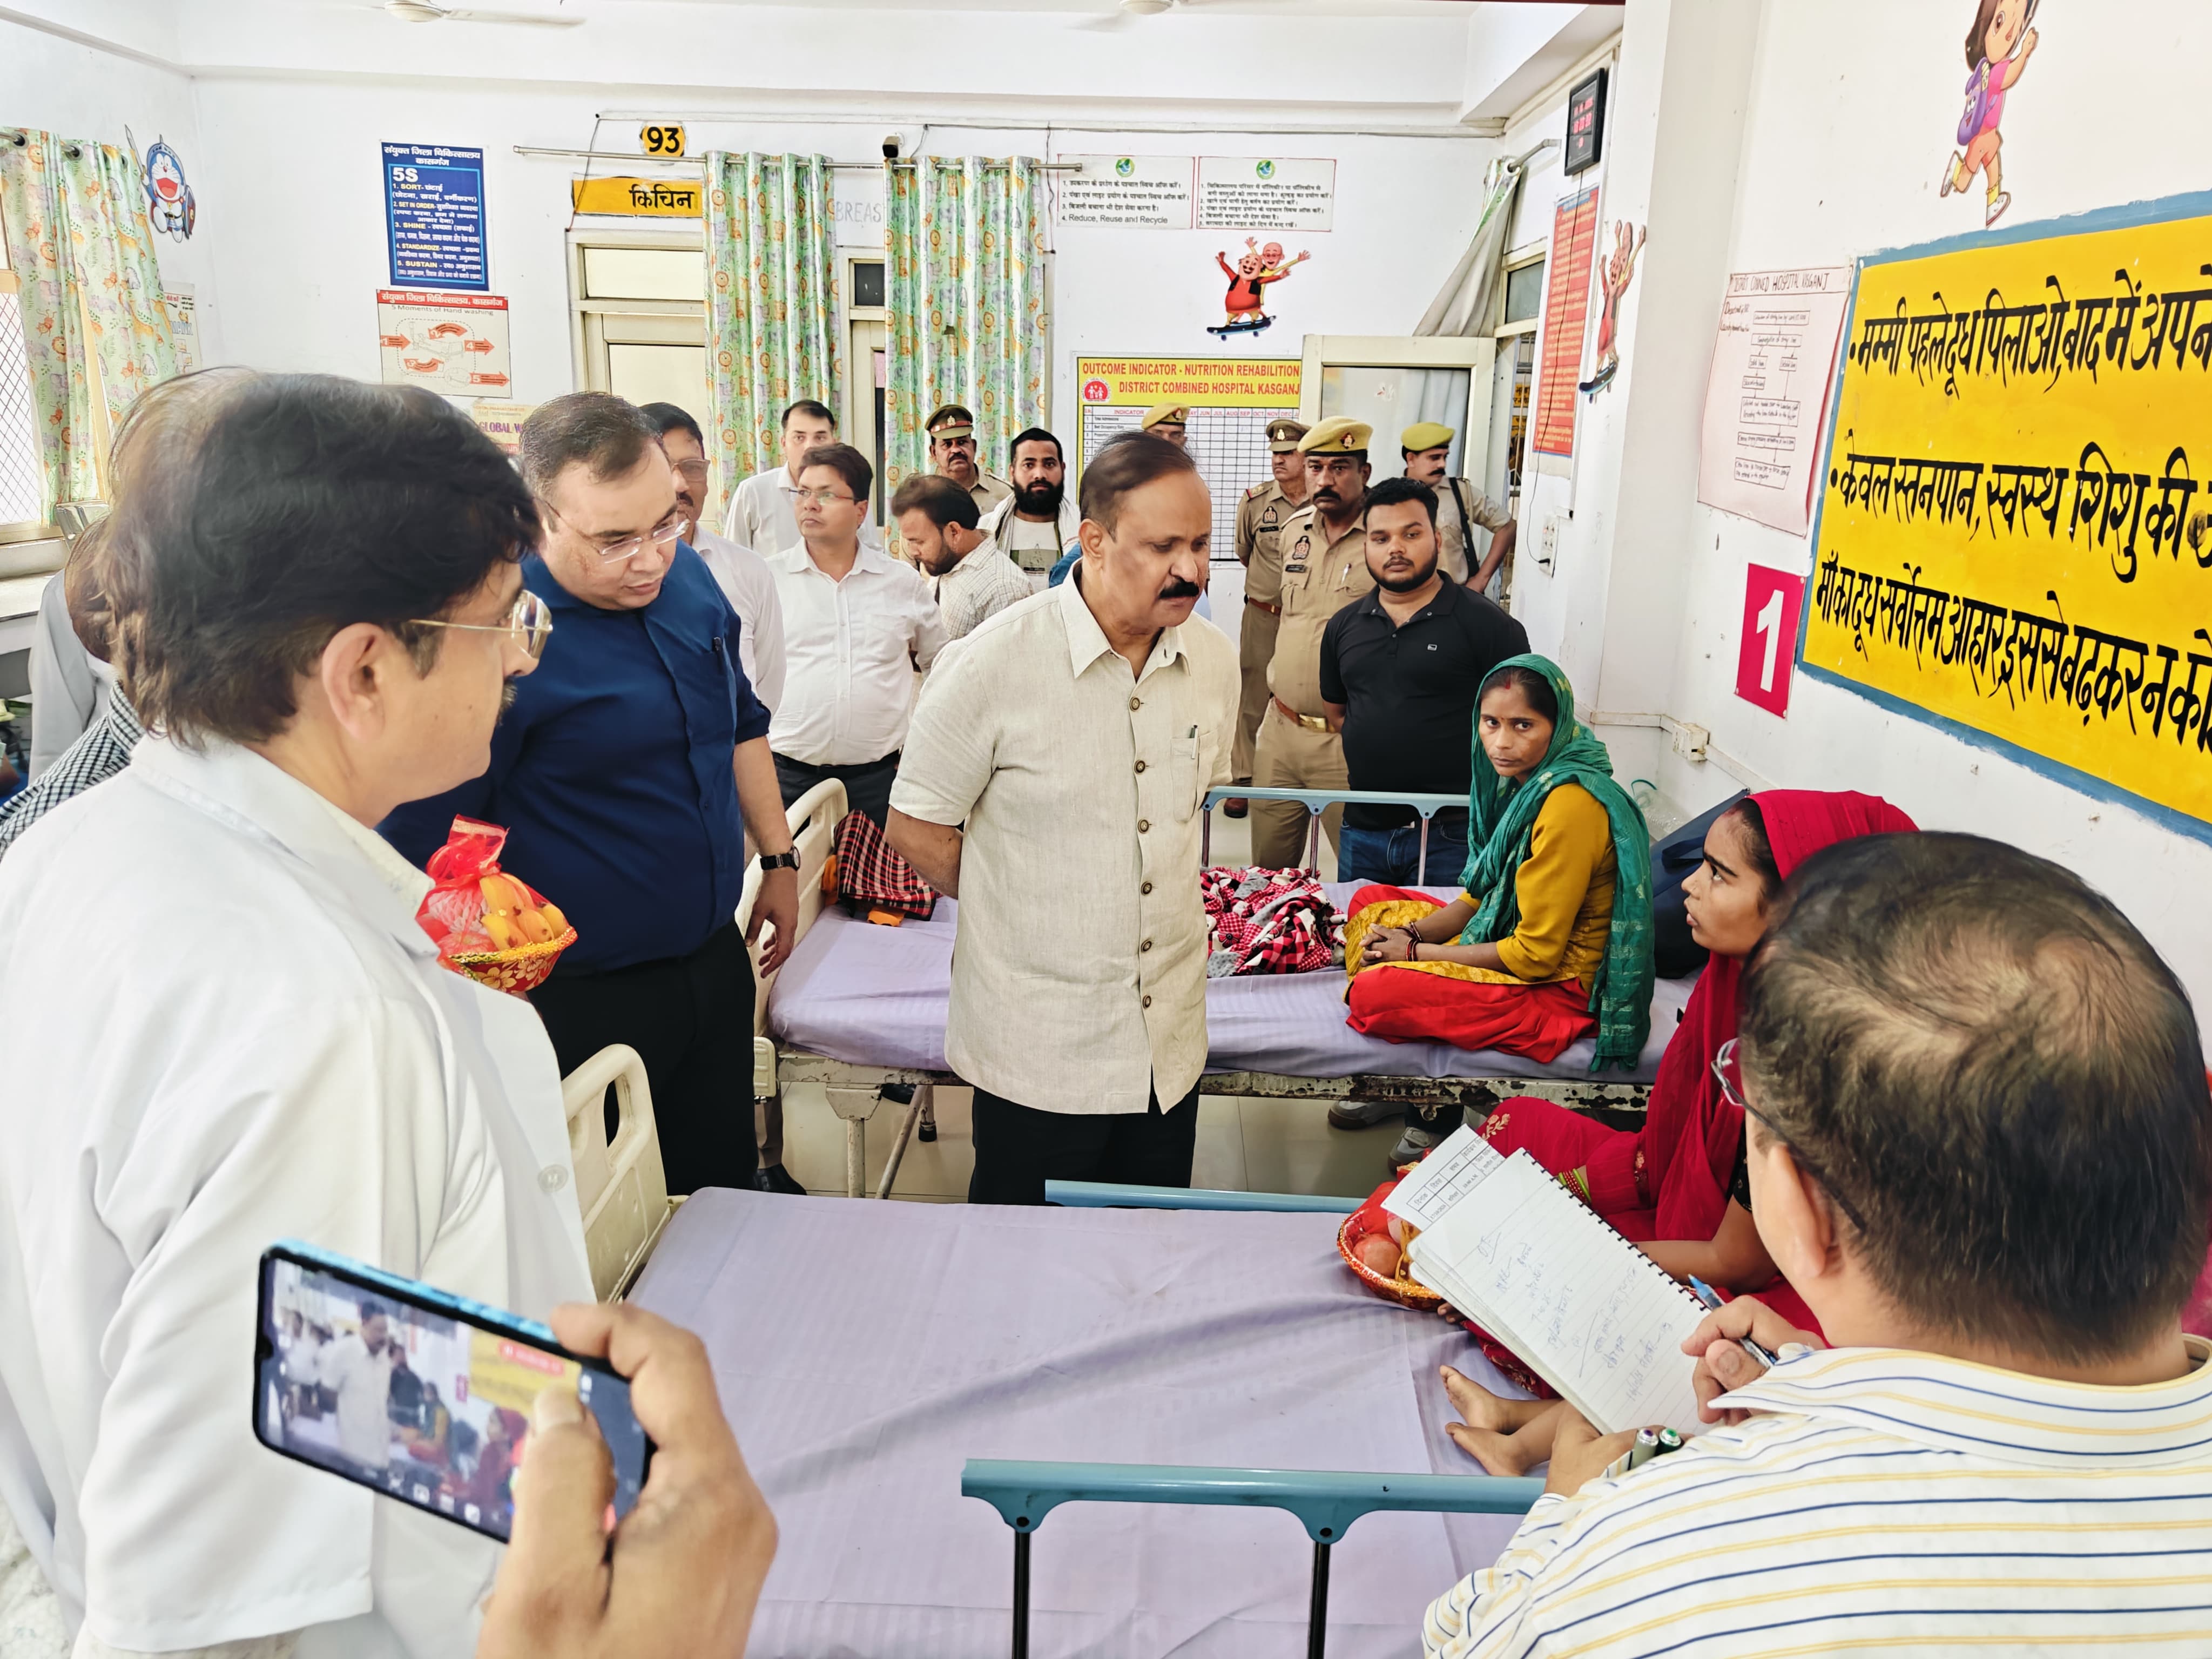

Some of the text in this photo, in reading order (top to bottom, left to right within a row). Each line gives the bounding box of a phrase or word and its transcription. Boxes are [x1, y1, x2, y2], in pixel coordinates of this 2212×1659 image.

[647, 126, 679, 153] 93
[384, 146, 409, 157] संयुक्त
[412, 146, 432, 156] जिला
[393, 167, 418, 182] 5S
[629, 184, 695, 209] किचिन
[836, 201, 882, 222] BREAS
[1069, 214, 1098, 222] Reduce,
[1140, 216, 1168, 225] Recycle
[382, 292, 405, 303] संयुक्त
[407, 293, 425, 302] जिला
[1858, 296, 1908, 376] मम्मी
[1908, 291, 1953, 387] पहले
[1945, 309, 1981, 400] दूध
[2062, 297, 2113, 385] बाद
[2106, 268, 2142, 372] में
[1083, 363, 1299, 377] OUTCOME INDICATOR NUTRITION REHABILITION
[1120, 381, 1159, 393] DISTRICT
[1163, 382, 1209, 394] COMBINED
[1212, 383, 1255, 394] HOSPITAL
[1258, 383, 1299, 395] KASGANJ
[1840, 428, 1897, 520] केवल
[1987, 464, 2069, 541] स्वस्थ
[2069, 441, 2151, 583] शिशु
[2146, 446, 2198, 562] की
[1757, 590, 1784, 693] 1
[1817, 549, 1838, 624] माँ
[1833, 567, 1856, 629] का
[1852, 572, 1883, 662] दूध
[1880, 562, 1950, 672] सर्वोत्तम
[2001, 590, 2069, 711] इससे
[2060, 625, 2149, 736] बढ़कर
[2141, 644, 2179, 739] न
